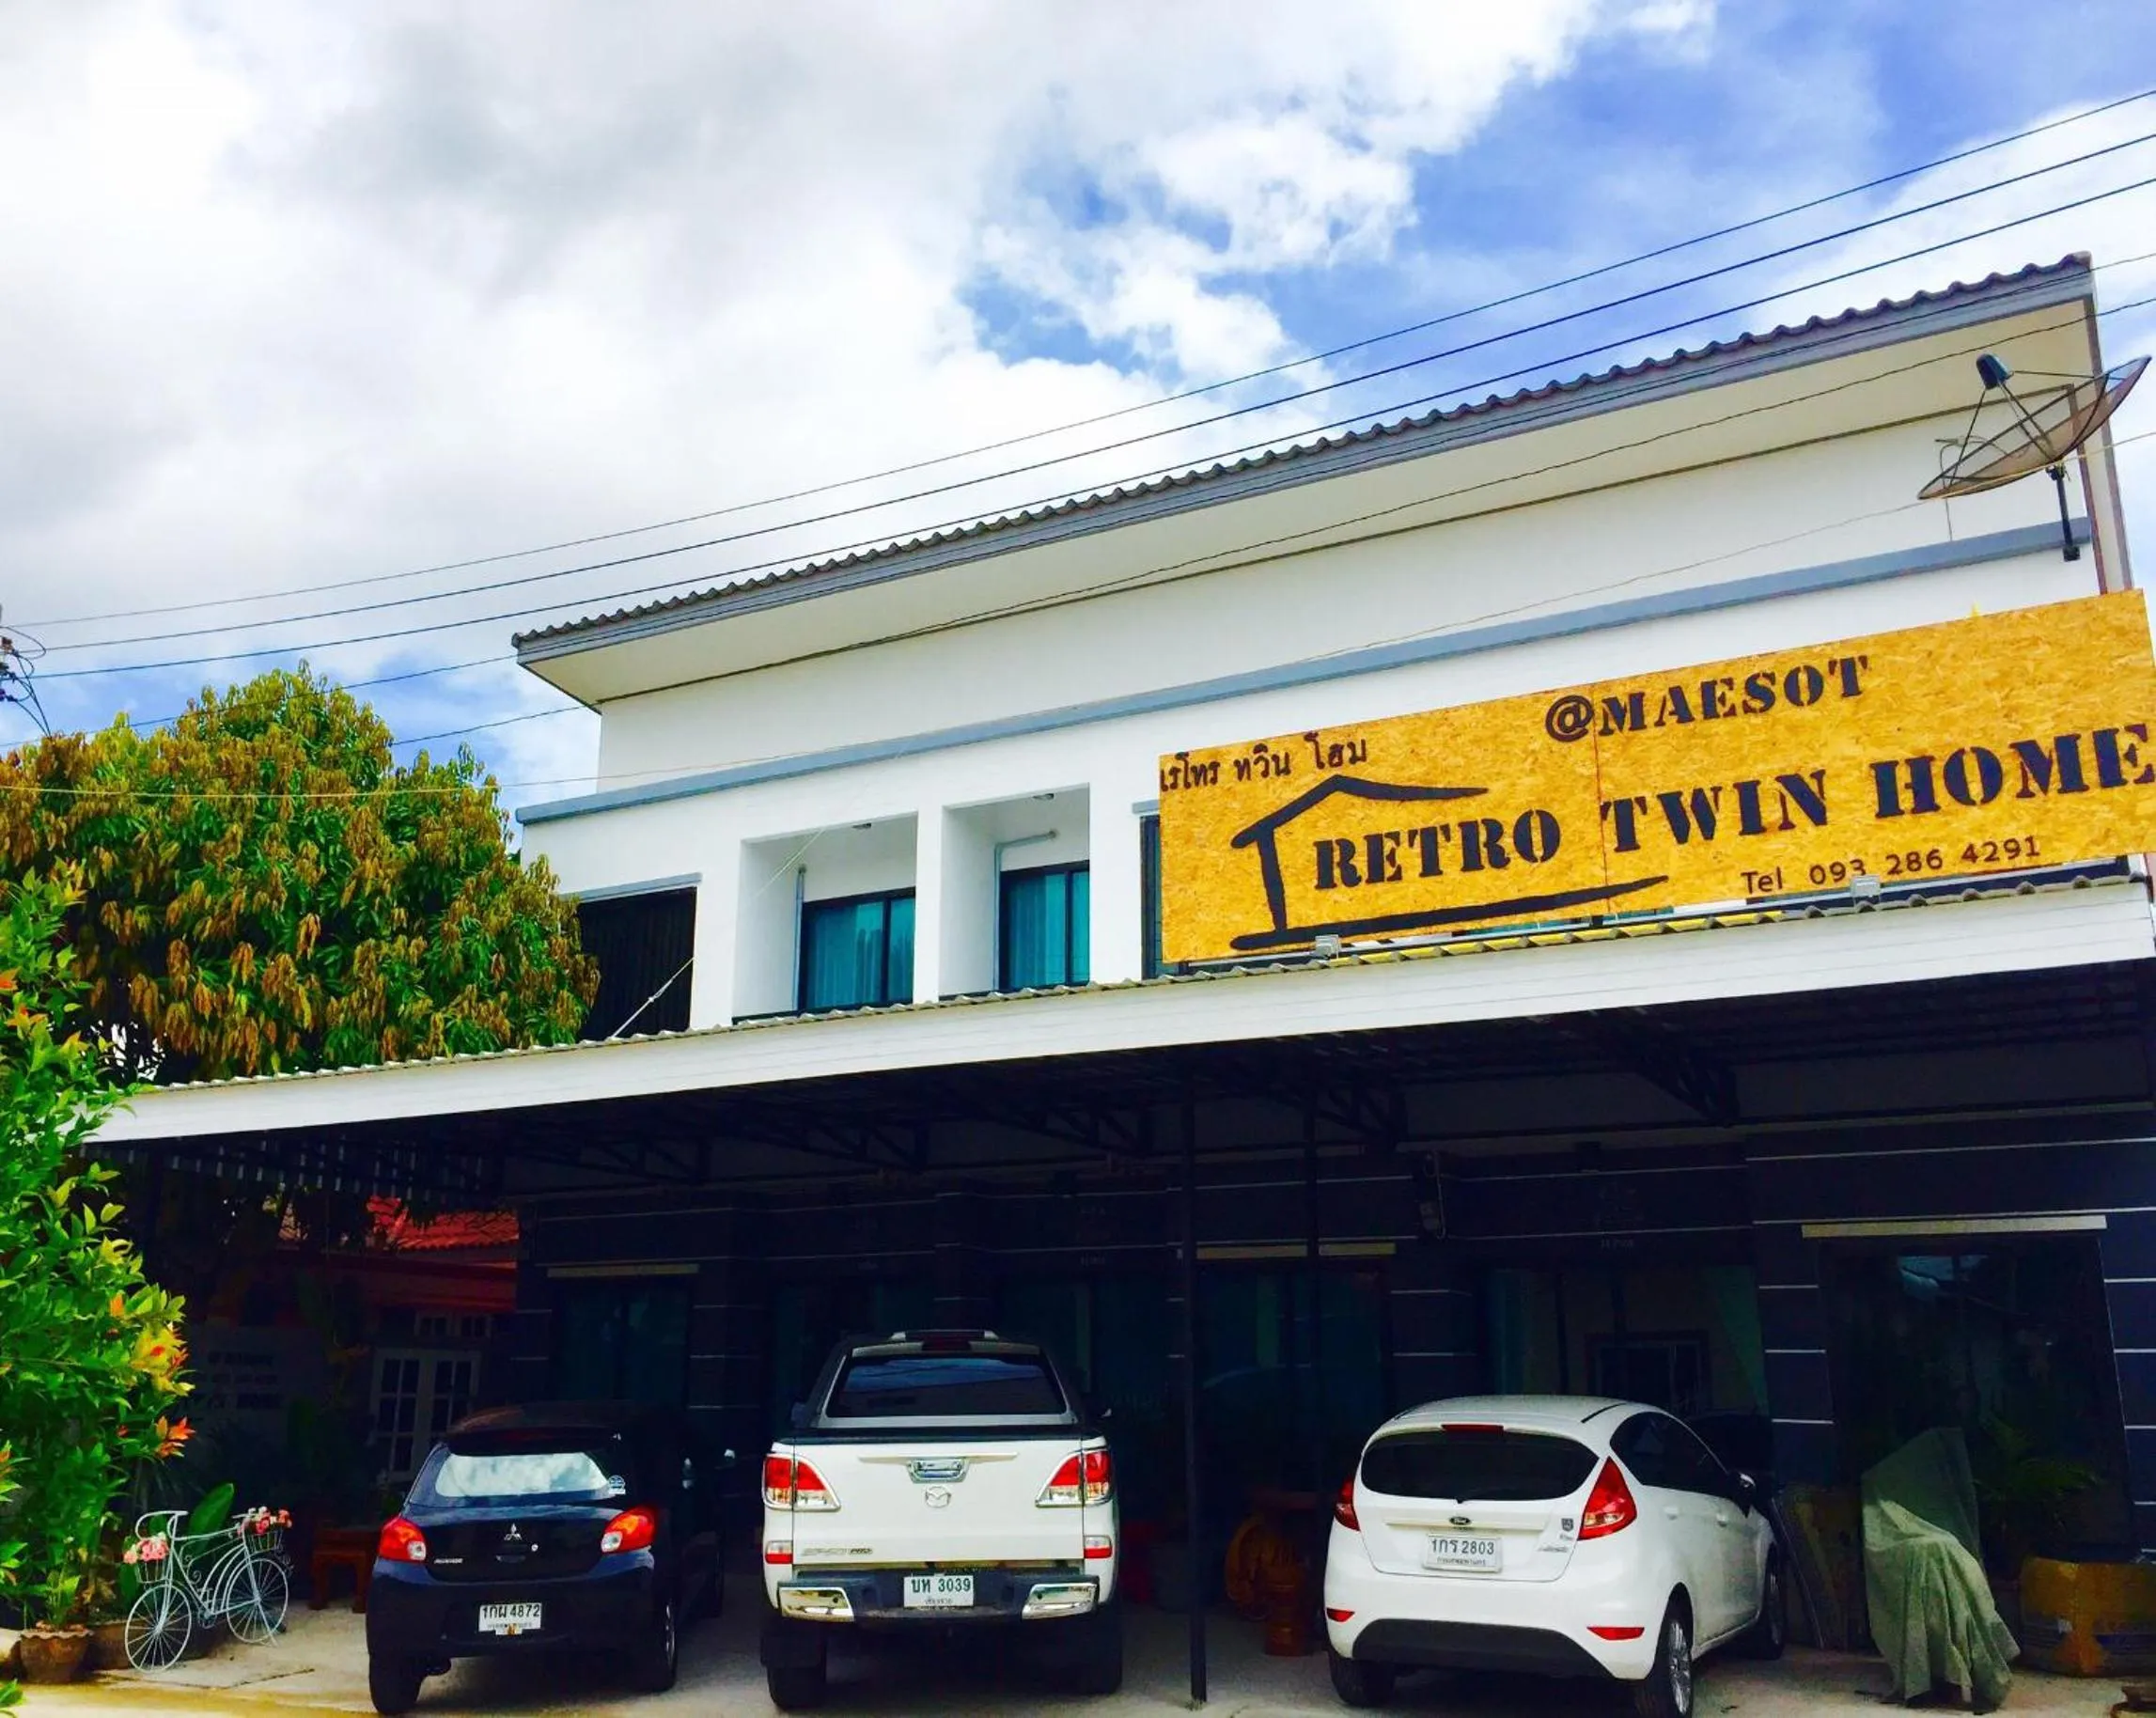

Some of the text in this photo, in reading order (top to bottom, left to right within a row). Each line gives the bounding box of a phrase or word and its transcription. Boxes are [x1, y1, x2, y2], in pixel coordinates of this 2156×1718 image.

[1544, 655, 1871, 742] @MAESOT
[1160, 731, 1367, 791] เรโทร ทวิน โฮม
[1315, 723, 2156, 889] RETRO TWIN HOME
[1741, 836, 2040, 894] Tel 093 286 4291
[1461, 1540, 1494, 1555] 2803
[510, 1603, 540, 1617] 4872
[937, 1577, 972, 1593] 3039
